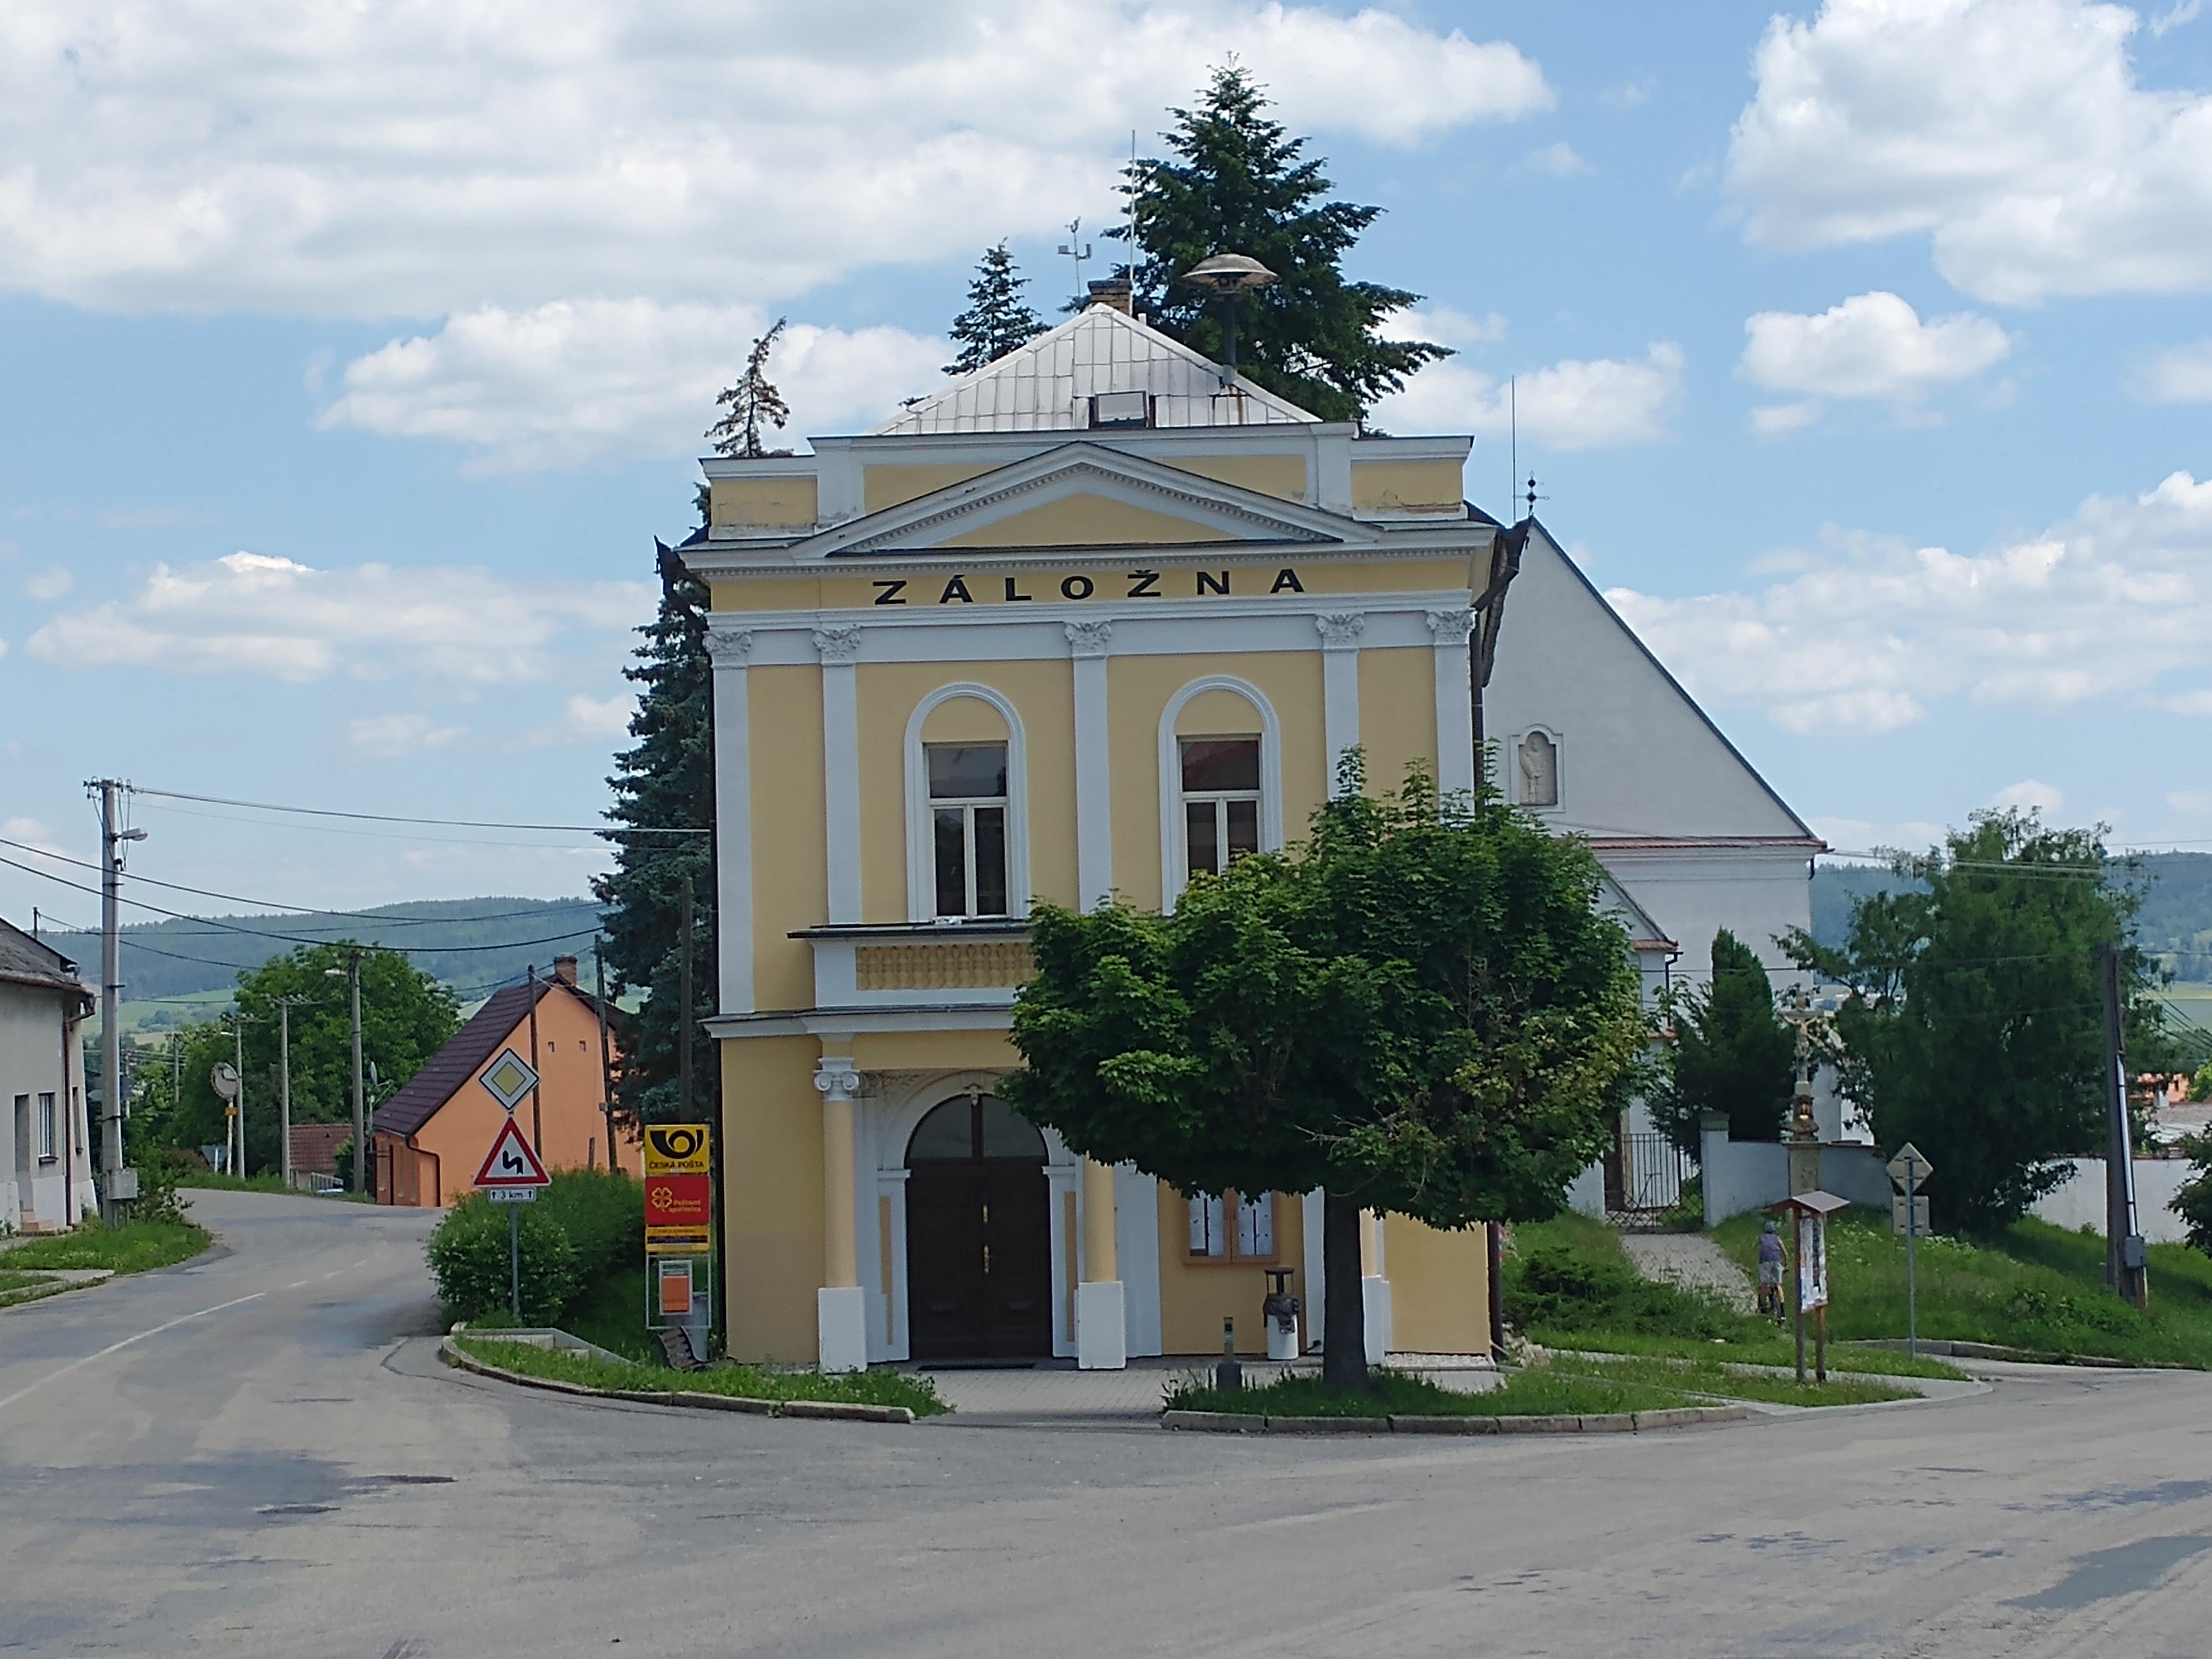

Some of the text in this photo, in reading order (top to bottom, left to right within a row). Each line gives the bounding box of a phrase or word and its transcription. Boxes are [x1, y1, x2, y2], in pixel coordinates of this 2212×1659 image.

[872, 568, 1305, 606] ZÁLOŽNA
[649, 1159, 704, 1169] ČESKÁ POŠTA
[500, 1191, 506, 1199] 3
